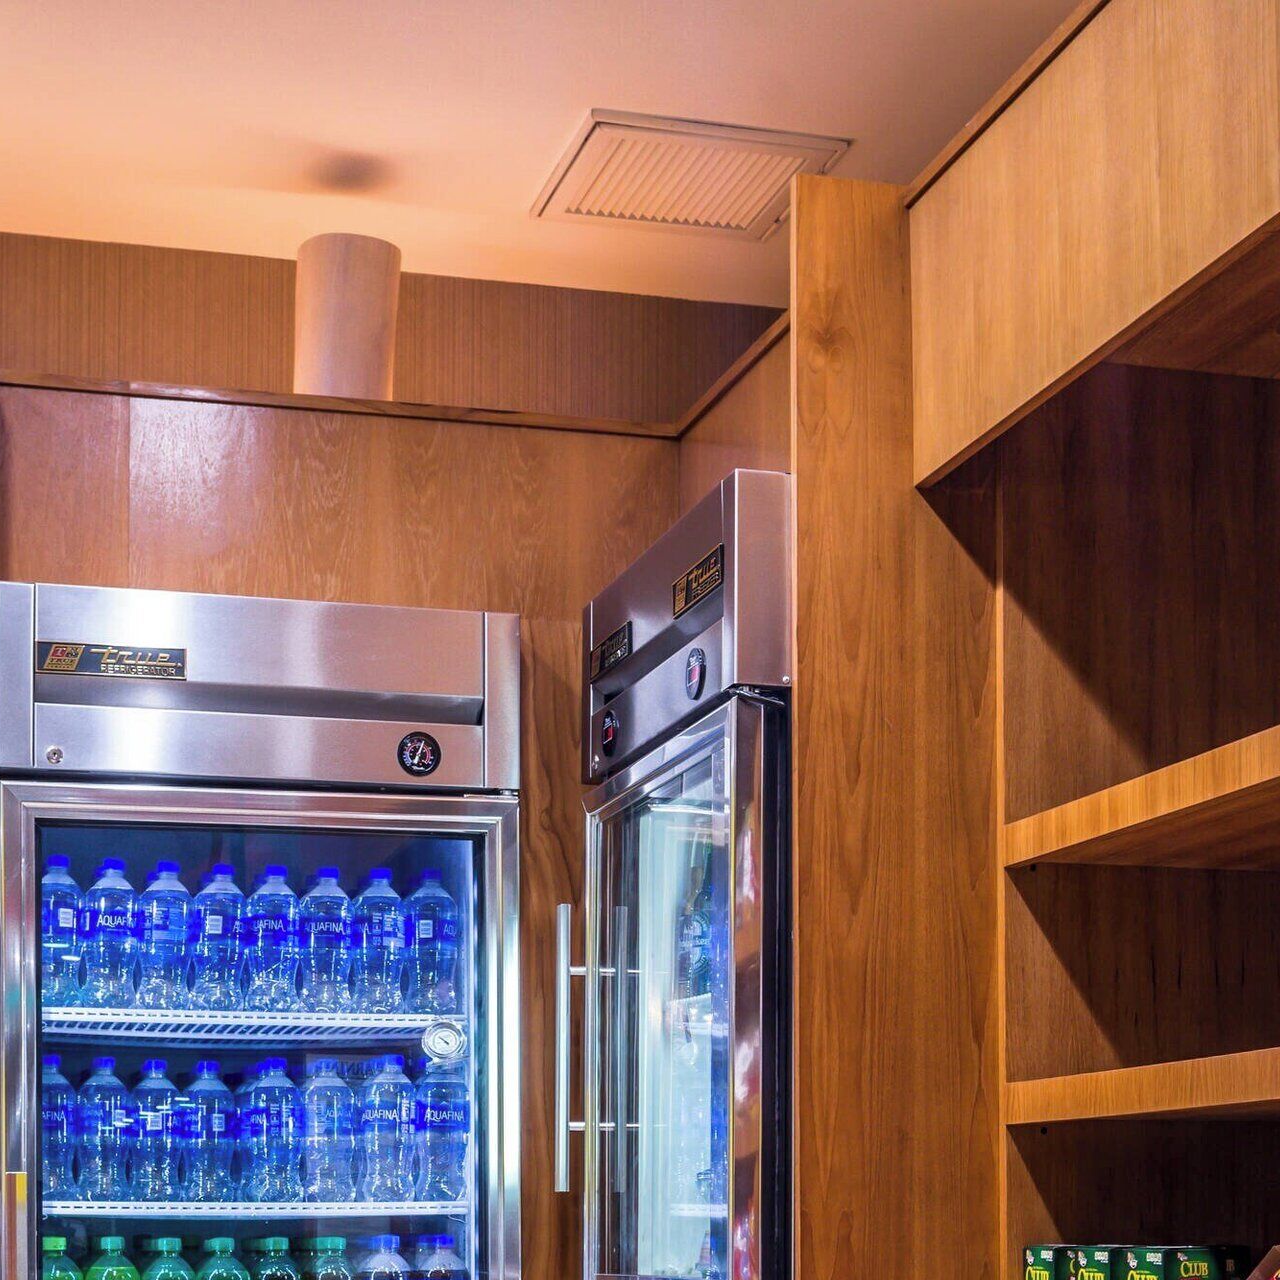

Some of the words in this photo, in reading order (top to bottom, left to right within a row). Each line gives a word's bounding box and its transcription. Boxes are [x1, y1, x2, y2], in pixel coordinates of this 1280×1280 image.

[100, 664, 176, 676] REFRIGERATOR
[361, 1109, 400, 1123] AQUAFINA
[424, 1109, 465, 1123] AQUAFINA
[1180, 1261, 1209, 1278] CLUB
